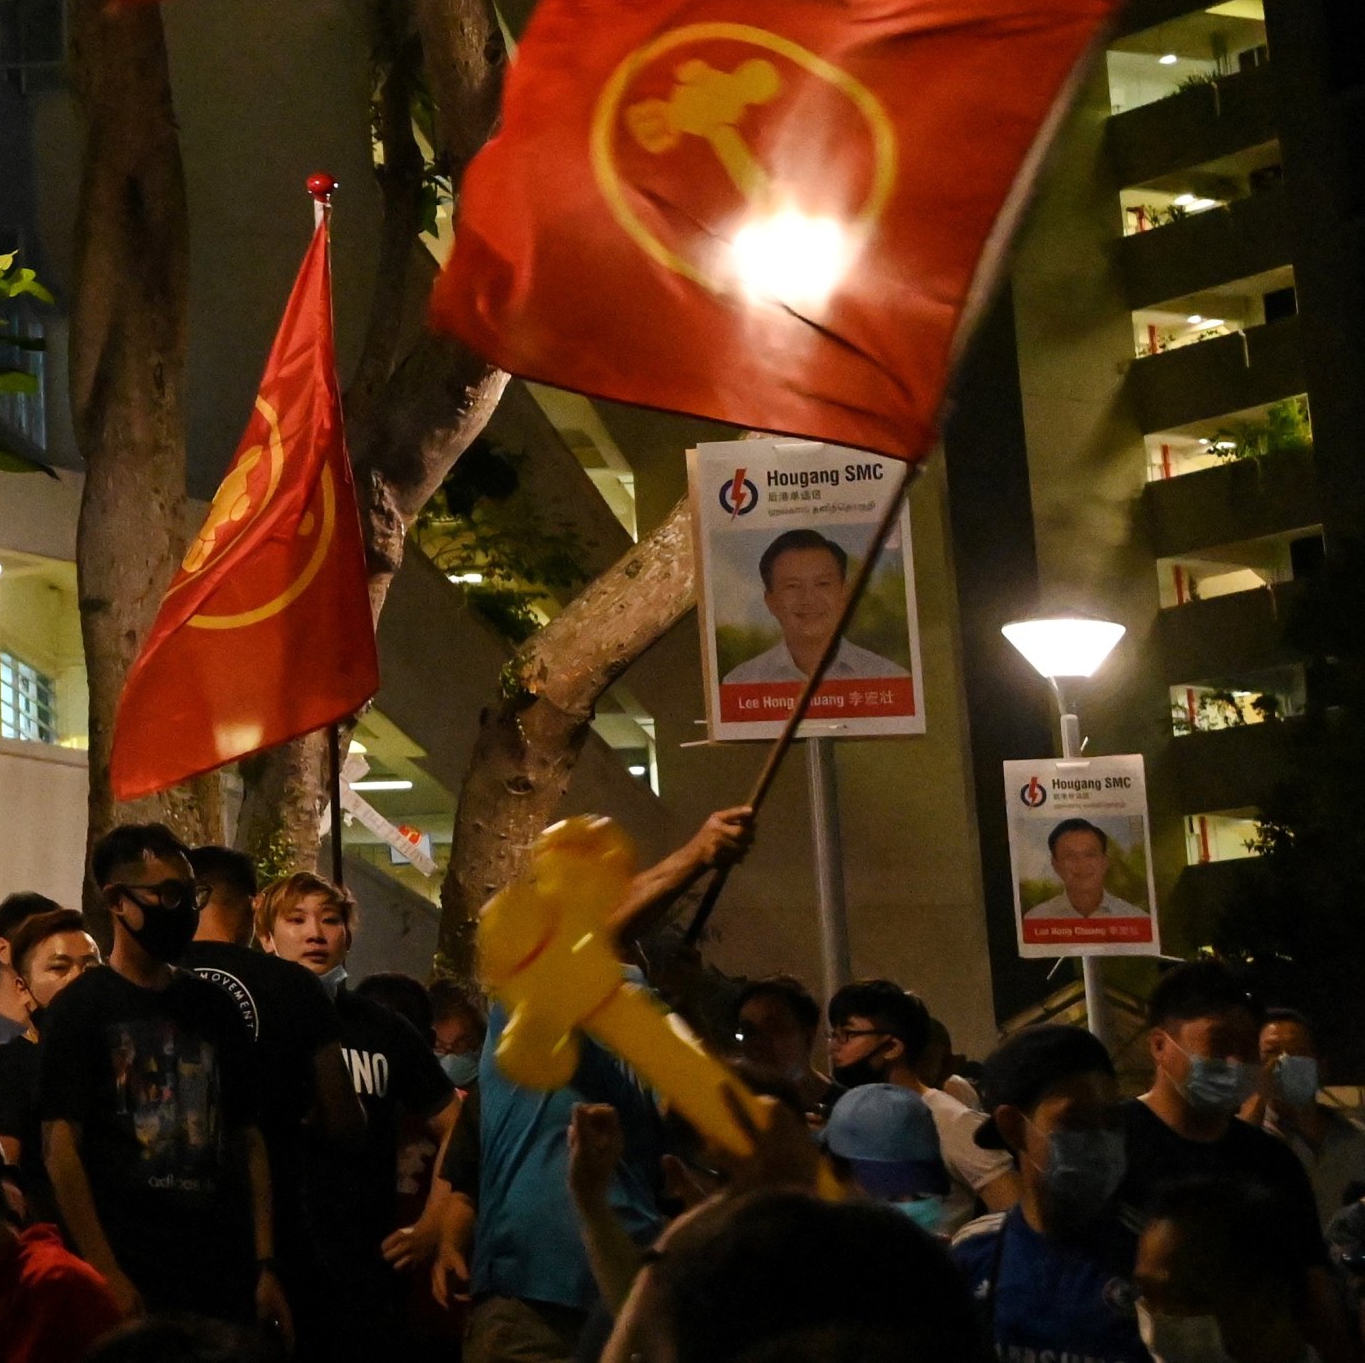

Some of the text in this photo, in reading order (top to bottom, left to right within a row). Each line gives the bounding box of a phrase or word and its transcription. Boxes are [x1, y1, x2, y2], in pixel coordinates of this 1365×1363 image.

[767, 463, 884, 488] Hougang SMC
[739, 695, 844, 710] Lee Hong uang
[1052, 777, 1131, 791] Hougang SMC
[200, 971, 254, 1028] MOVEMENT
